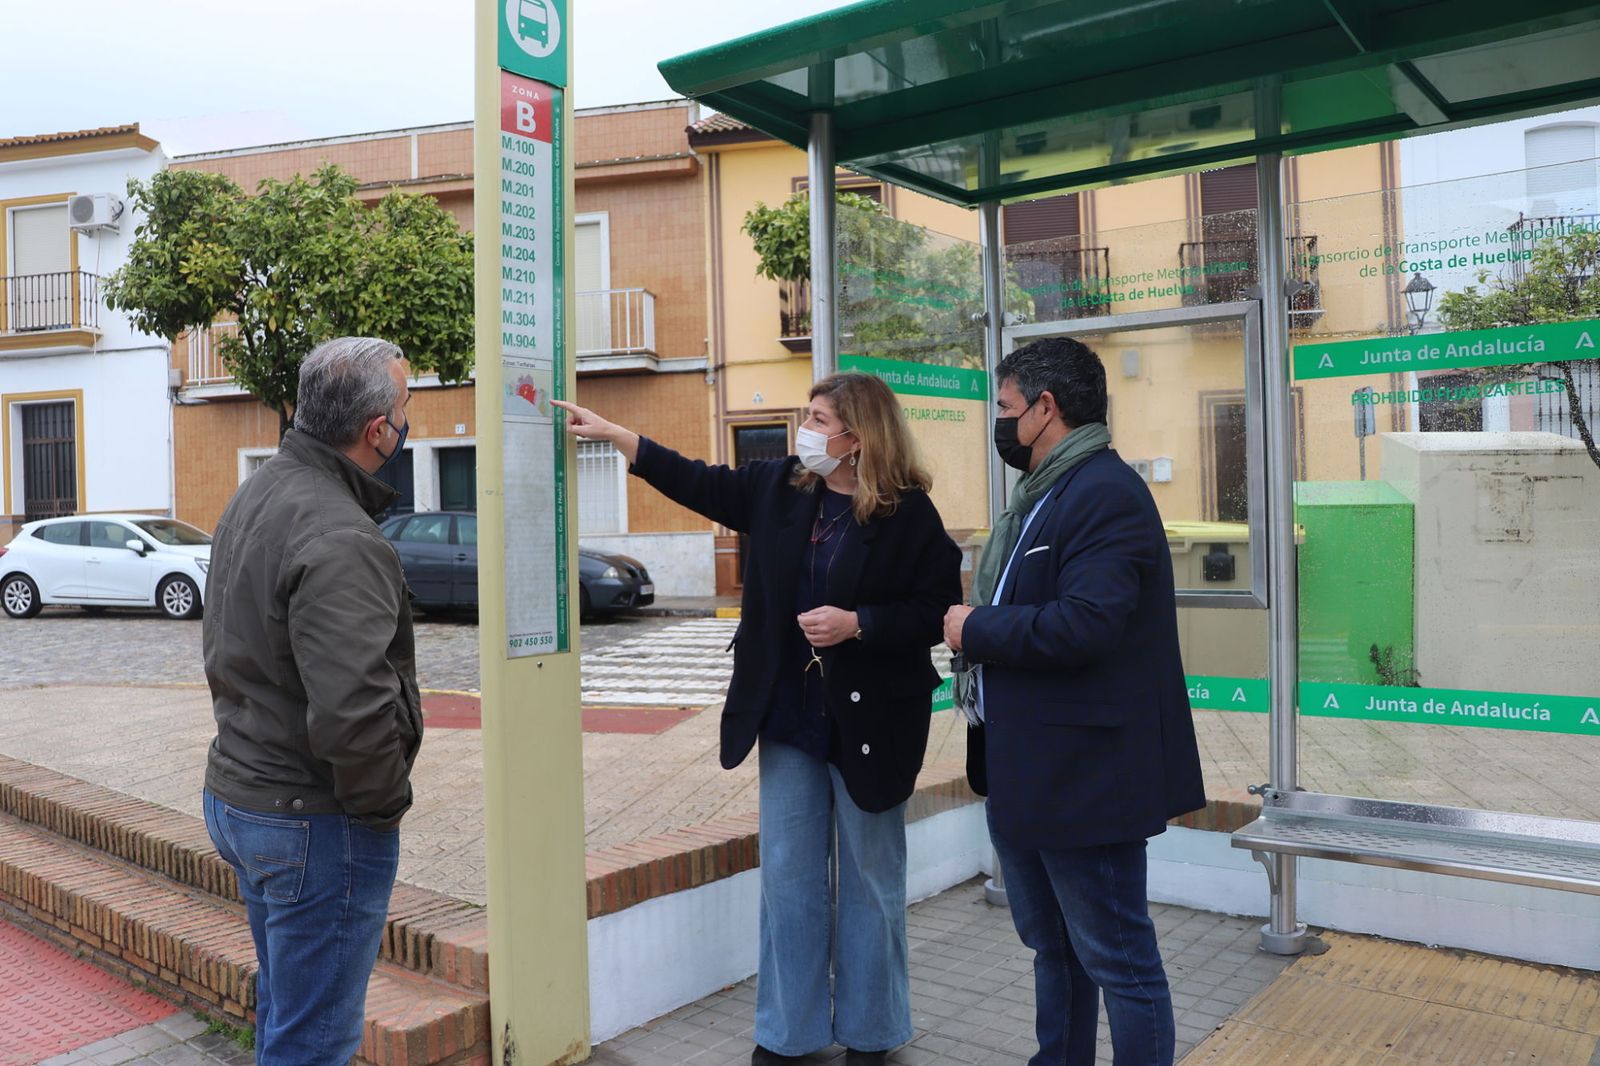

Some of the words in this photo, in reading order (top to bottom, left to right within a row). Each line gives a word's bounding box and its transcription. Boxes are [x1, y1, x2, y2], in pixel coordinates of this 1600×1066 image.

[512, 85, 540, 100] ZONA
[516, 100, 537, 133] B
[502, 136, 535, 156] M.100
[502, 157, 535, 177] M.200
[502, 179, 535, 198] M.201
[502, 201, 535, 220] M.202
[502, 223, 536, 241] M.203
[502, 244, 536, 263] M.204
[1298, 247, 1370, 266] Consorcio
[1374, 244, 1392, 258] de
[1398, 235, 1480, 254] Transporte
[1360, 264, 1378, 278] de
[1382, 262, 1395, 275] la
[1399, 258, 1443, 273] Costa
[1448, 254, 1467, 268] de
[1473, 248, 1532, 265] Huelva
[502, 266, 536, 284] M.210
[502, 288, 535, 306] M.211
[1091, 290, 1125, 305] Costa
[1129, 288, 1144, 300] de
[1148, 283, 1195, 298] Huelva
[502, 310, 536, 328] M.304
[502, 332, 536, 349] M.904
[1360, 350, 1412, 365] Junta
[1417, 345, 1440, 360] de
[1445, 334, 1545, 358] Andalucía
[904, 371, 915, 385] de
[917, 373, 960, 390] Andalucía
[1351, 388, 1434, 406] PROHIBIDO
[1437, 384, 1480, 401] FIJAR
[1483, 379, 1565, 398] CARTELES
[911, 408, 930, 420] FIJAR
[932, 408, 966, 422] CARTELES
[509, 638, 522, 648] 902
[525, 636, 538, 647] 450
[540, 634, 553, 646] 550
[1365, 696, 1417, 713] Junta
[1423, 699, 1446, 715] de
[1451, 700, 1550, 721] Andalucía
